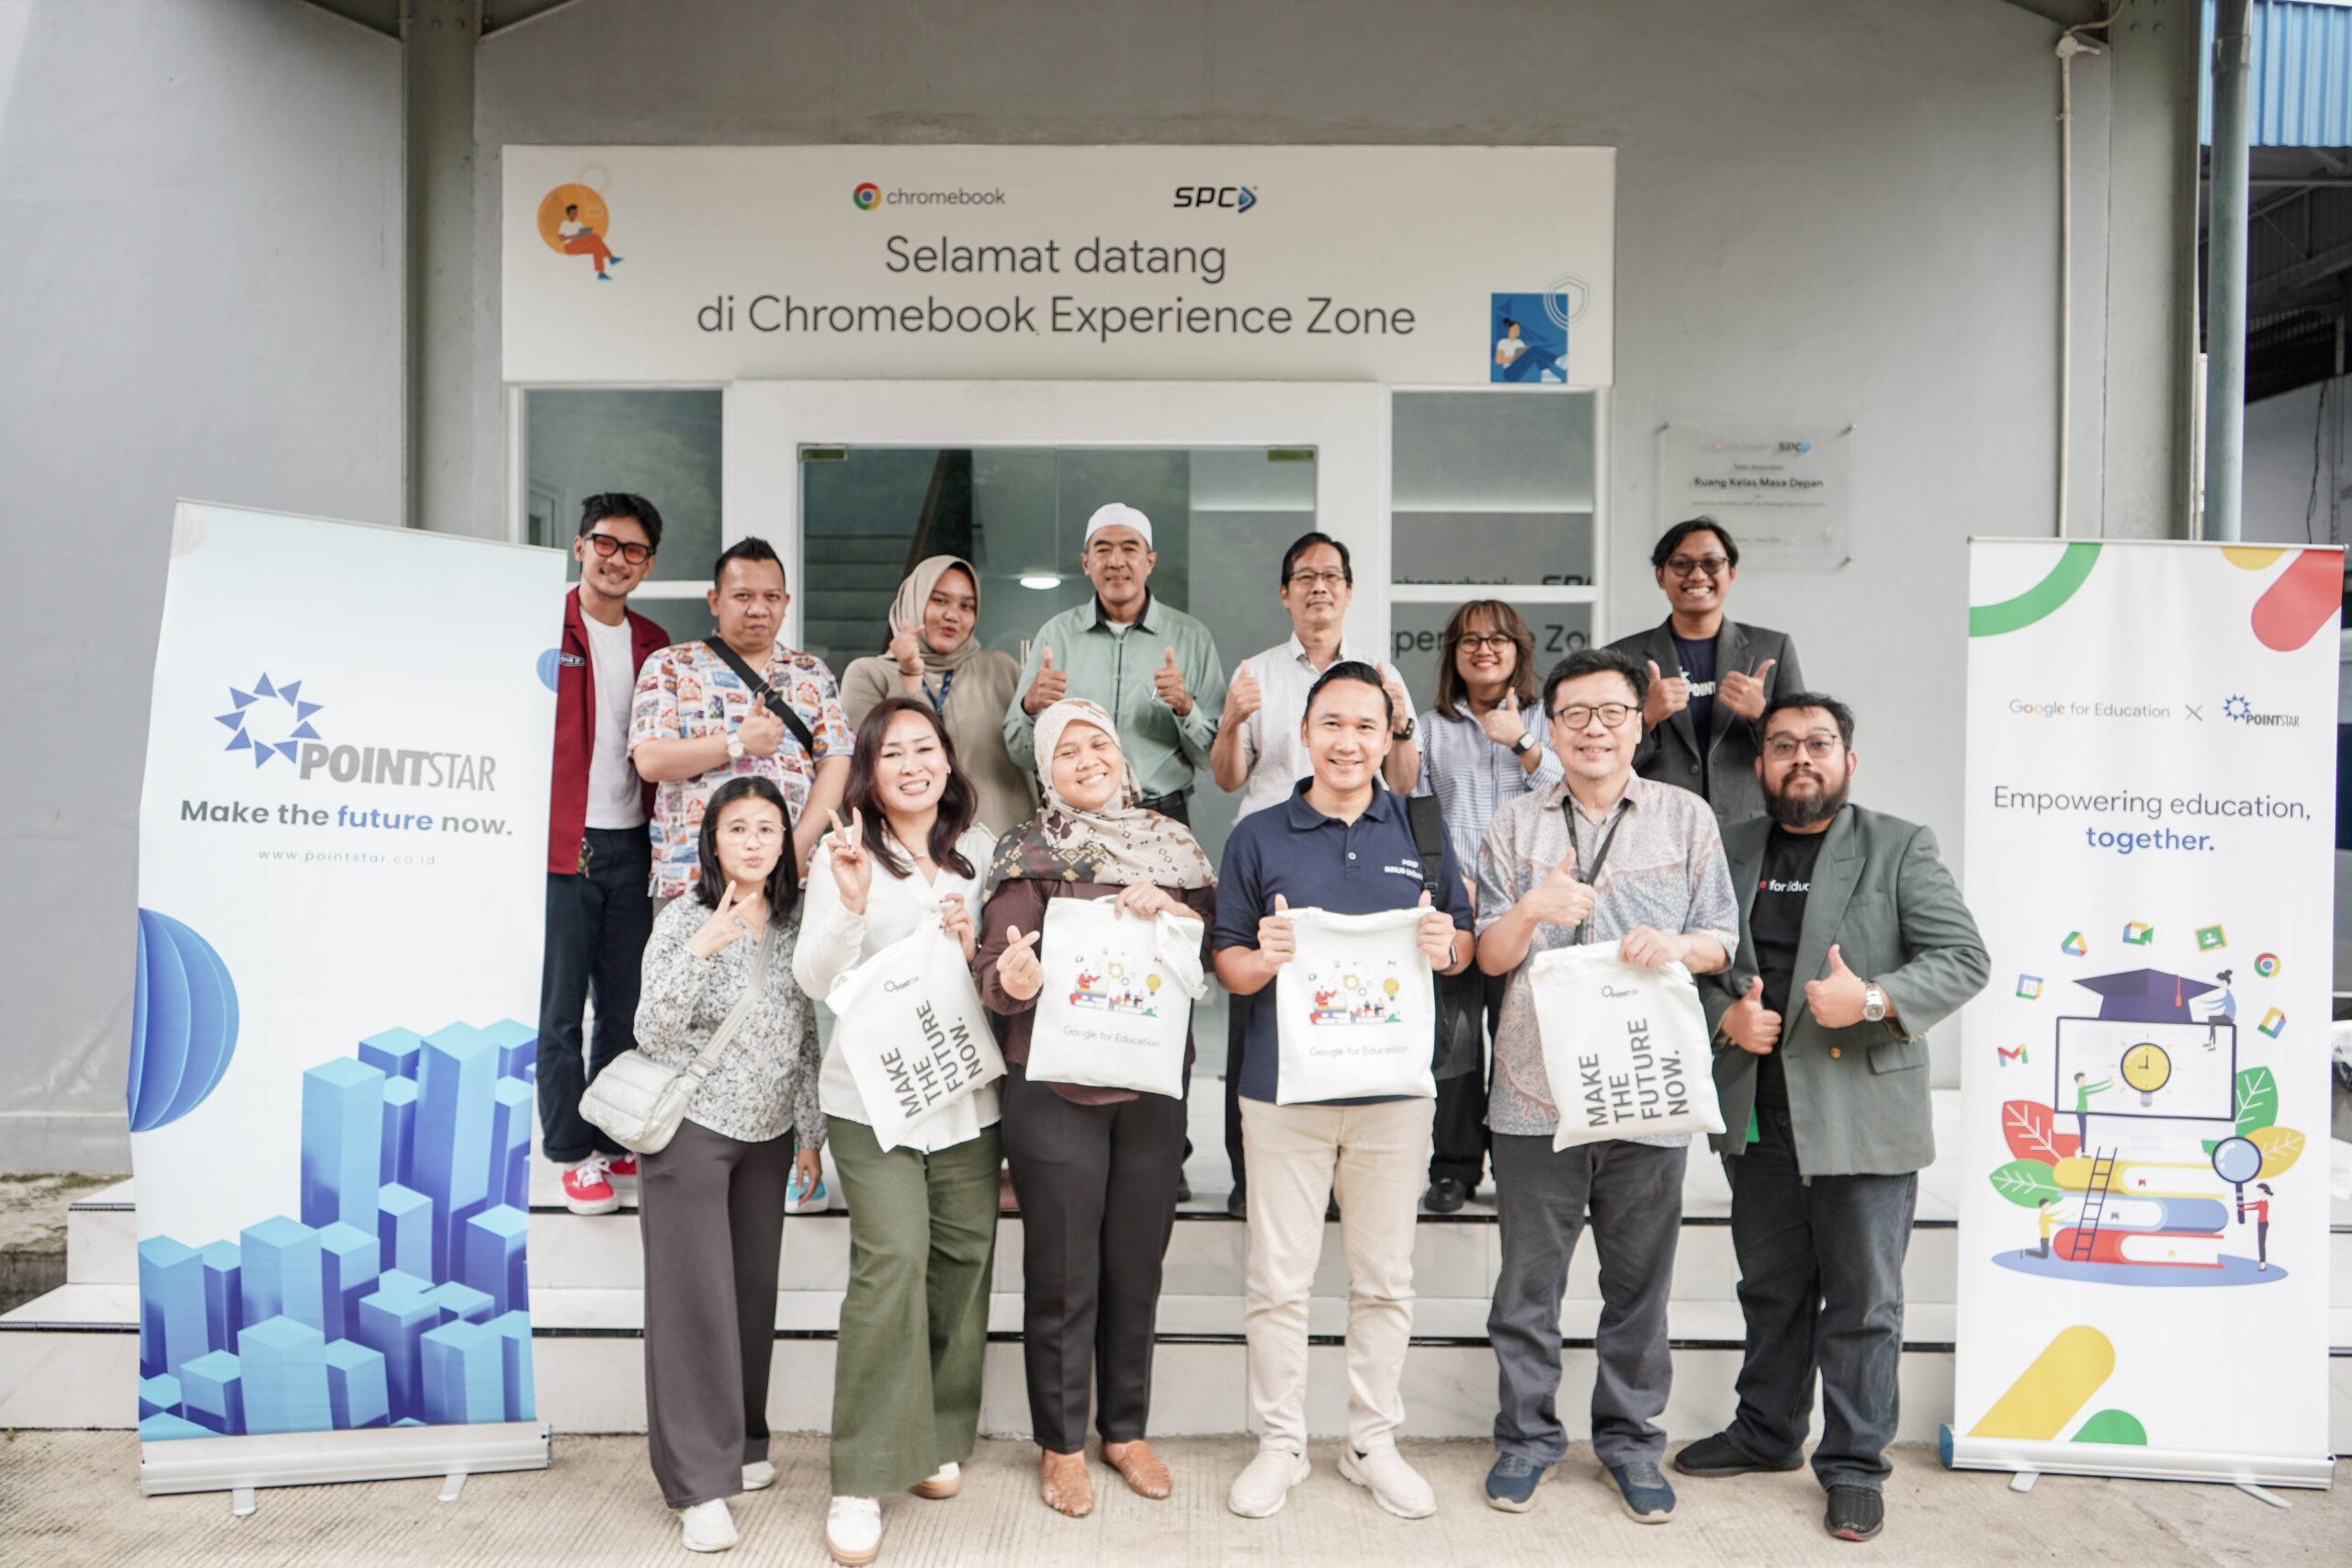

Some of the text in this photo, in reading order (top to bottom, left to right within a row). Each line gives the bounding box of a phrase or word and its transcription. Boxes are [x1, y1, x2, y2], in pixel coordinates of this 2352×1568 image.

[887, 187, 1006, 206] chromebook
[1173, 186, 1238, 209] SPC
[886, 234, 1227, 285] Selamat datang
[697, 294, 1416, 343] di Chromebook Experience Zone
[1694, 476, 1824, 490] Ruang Kelas Masa Depan
[2008, 698, 2066, 717] Google
[2070, 703, 2090, 716] for
[2094, 703, 2170, 718] Education
[2245, 713, 2300, 727] POINTSTAR
[299, 742, 497, 792] POINTSTAR
[180, 799, 513, 836] Make the future now.
[1994, 785, 2312, 821] Empowering education,
[258, 849, 435, 865] www.pointstar.co.id
[2085, 827, 2215, 854] together.
[1769, 879, 1786, 892] for
[916, 999, 964, 1093] FUTURE
[949, 1016, 983, 1079] NOW.
[1063, 1025, 1159, 1048] Google for Education
[1309, 1045, 1409, 1058] Google for Education
[880, 1047, 922, 1119] MAKE
[912, 1055, 942, 1106] THE
[1578, 1054, 1609, 1127] MAKE
[1627, 1019, 1662, 1120] FUTURE
[1660, 1050, 1690, 1116] NOW.
[1609, 1073, 1634, 1123] THE
